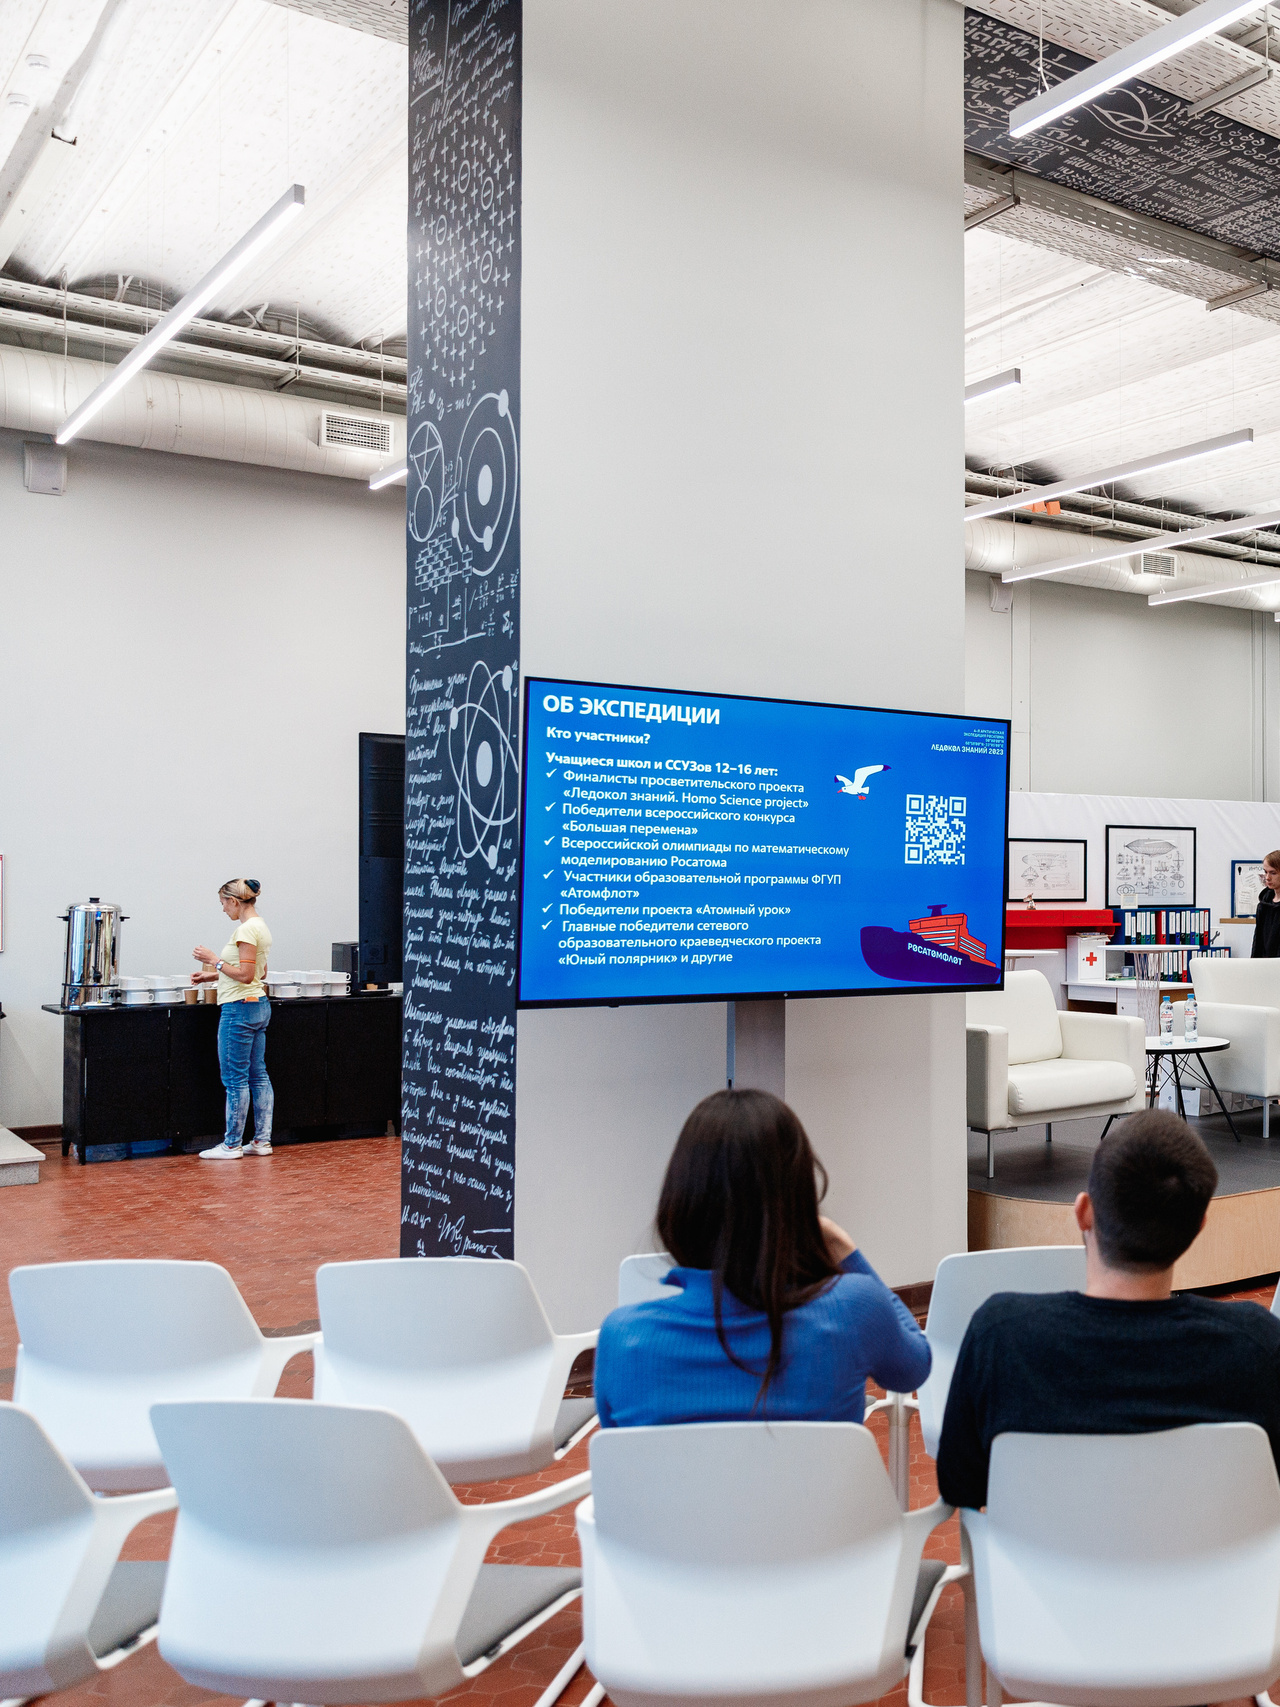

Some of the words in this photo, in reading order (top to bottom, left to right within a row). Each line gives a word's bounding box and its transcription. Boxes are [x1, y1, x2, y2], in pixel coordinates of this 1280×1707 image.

[543, 695, 573, 713] ОБ
[580, 698, 720, 725] ЭКСПЕДИЦИИ
[546, 727, 571, 738] Кто
[574, 731, 650, 744] участники?
[931, 744, 960, 752] ЛЕДОКОЛ
[546, 752, 613, 767] Учащиеся
[617, 759, 651, 768] школ
[665, 760, 712, 772] ССУЗов
[754, 767, 778, 776] лет:
[564, 770, 637, 784] Финалисты
[641, 776, 755, 790] просветительского
[758, 782, 805, 794] проекта
[564, 787, 627, 800] «Ледокол
[630, 790, 678, 802] знаний.
[682, 795, 716, 804] Homo
[720, 795, 761, 806] Science
[764, 796, 808, 809] project»
[563, 803, 641, 817] Победители
[645, 807, 740, 820] всероссийского
[744, 813, 795, 824] конкурса
[563, 821, 626, 833] «Большая
[630, 825, 698, 835] перемена»
[562, 837, 658, 851] Всероссийской
[662, 841, 731, 854] олимпиады
[735, 843, 748, 853] по
[752, 844, 849, 857] математическому
[561, 855, 667, 868] моделированию
[671, 856, 727, 868] Росатома
[564, 871, 631, 883] Участники
[635, 872, 740, 884] образовательной
[744, 874, 808, 885] программы
[812, 874, 841, 885] ФГУП
[561, 887, 639, 900] «Атомфлот»
[560, 904, 639, 916] Победители
[642, 905, 692, 916] проекта
[696, 904, 755, 915] «Атомный
[758, 906, 790, 917] урок»
[563, 921, 616, 932] Главные
[620, 920, 694, 932] победители
[697, 921, 748, 931] сетевого
[558, 937, 677, 948] образовательного
[680, 936, 773, 947] краеведческого
[776, 936, 821, 946] проекта
[559, 954, 606, 966] «Юный
[609, 954, 678, 966] полярник»
[681, 954, 688, 963] и
[691, 952, 733, 966] другие
[908, 942, 962, 965] РОСАТОМФЛОТ
